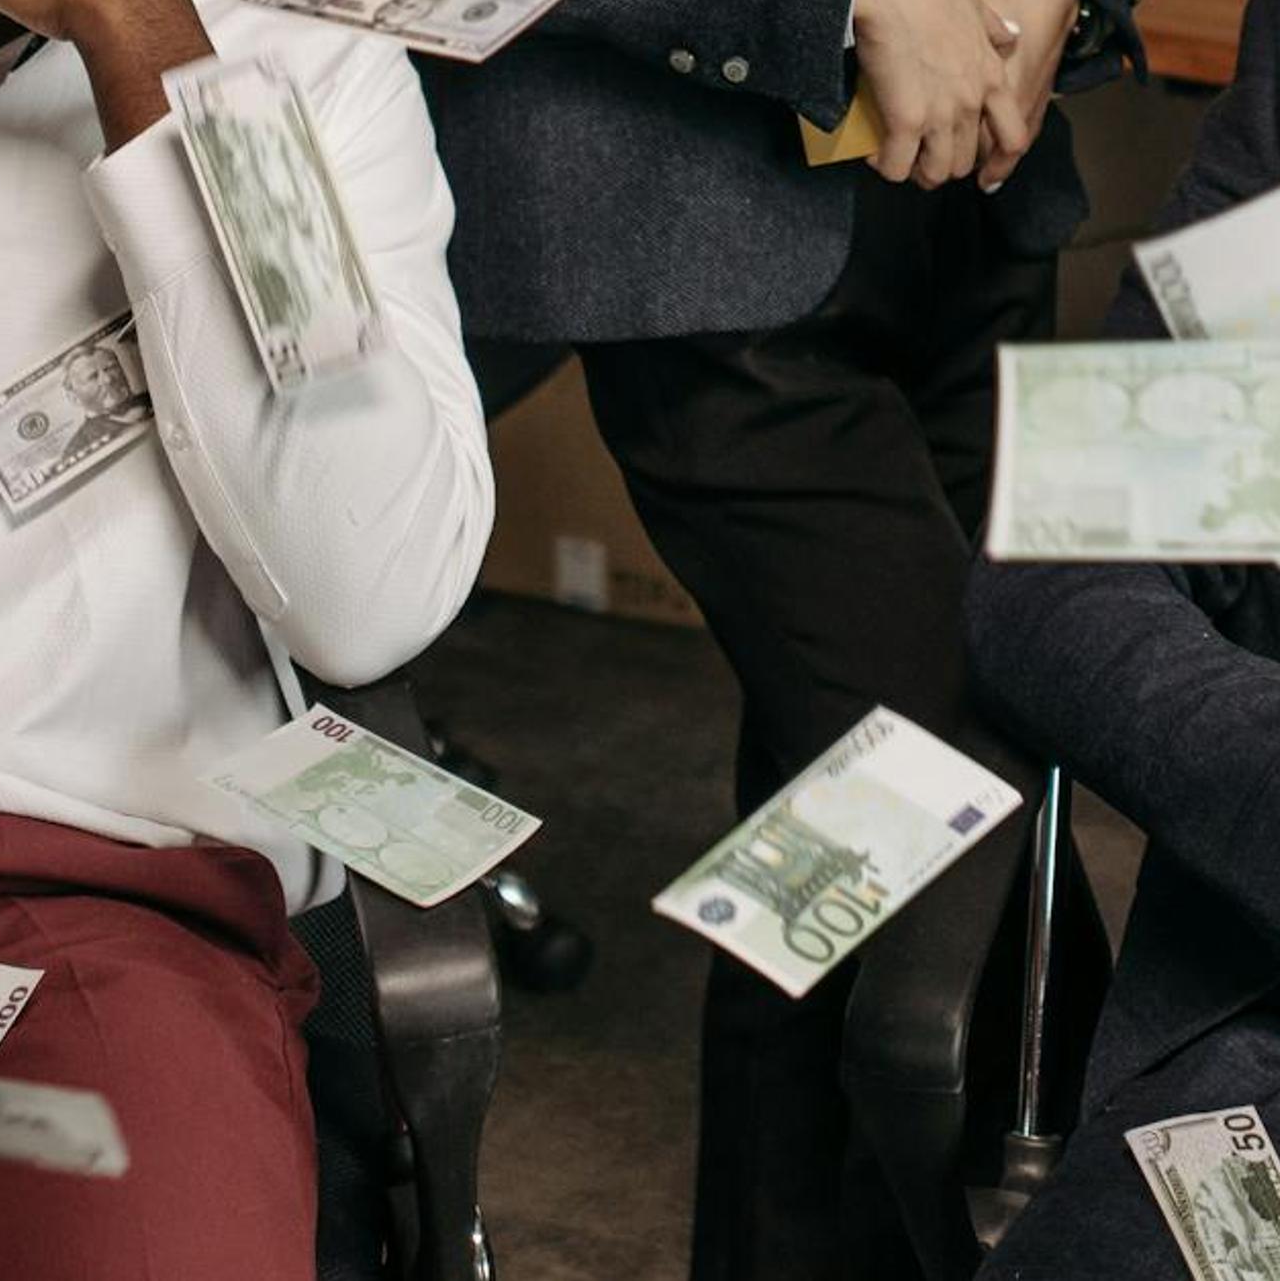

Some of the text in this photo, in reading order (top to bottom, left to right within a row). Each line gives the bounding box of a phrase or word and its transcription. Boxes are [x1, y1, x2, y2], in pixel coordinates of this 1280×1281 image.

[311, 715, 354, 744] 100
[480, 803, 530, 834] 100
[782, 883, 886, 965] 100
[1223, 1113, 1265, 1158] 50
